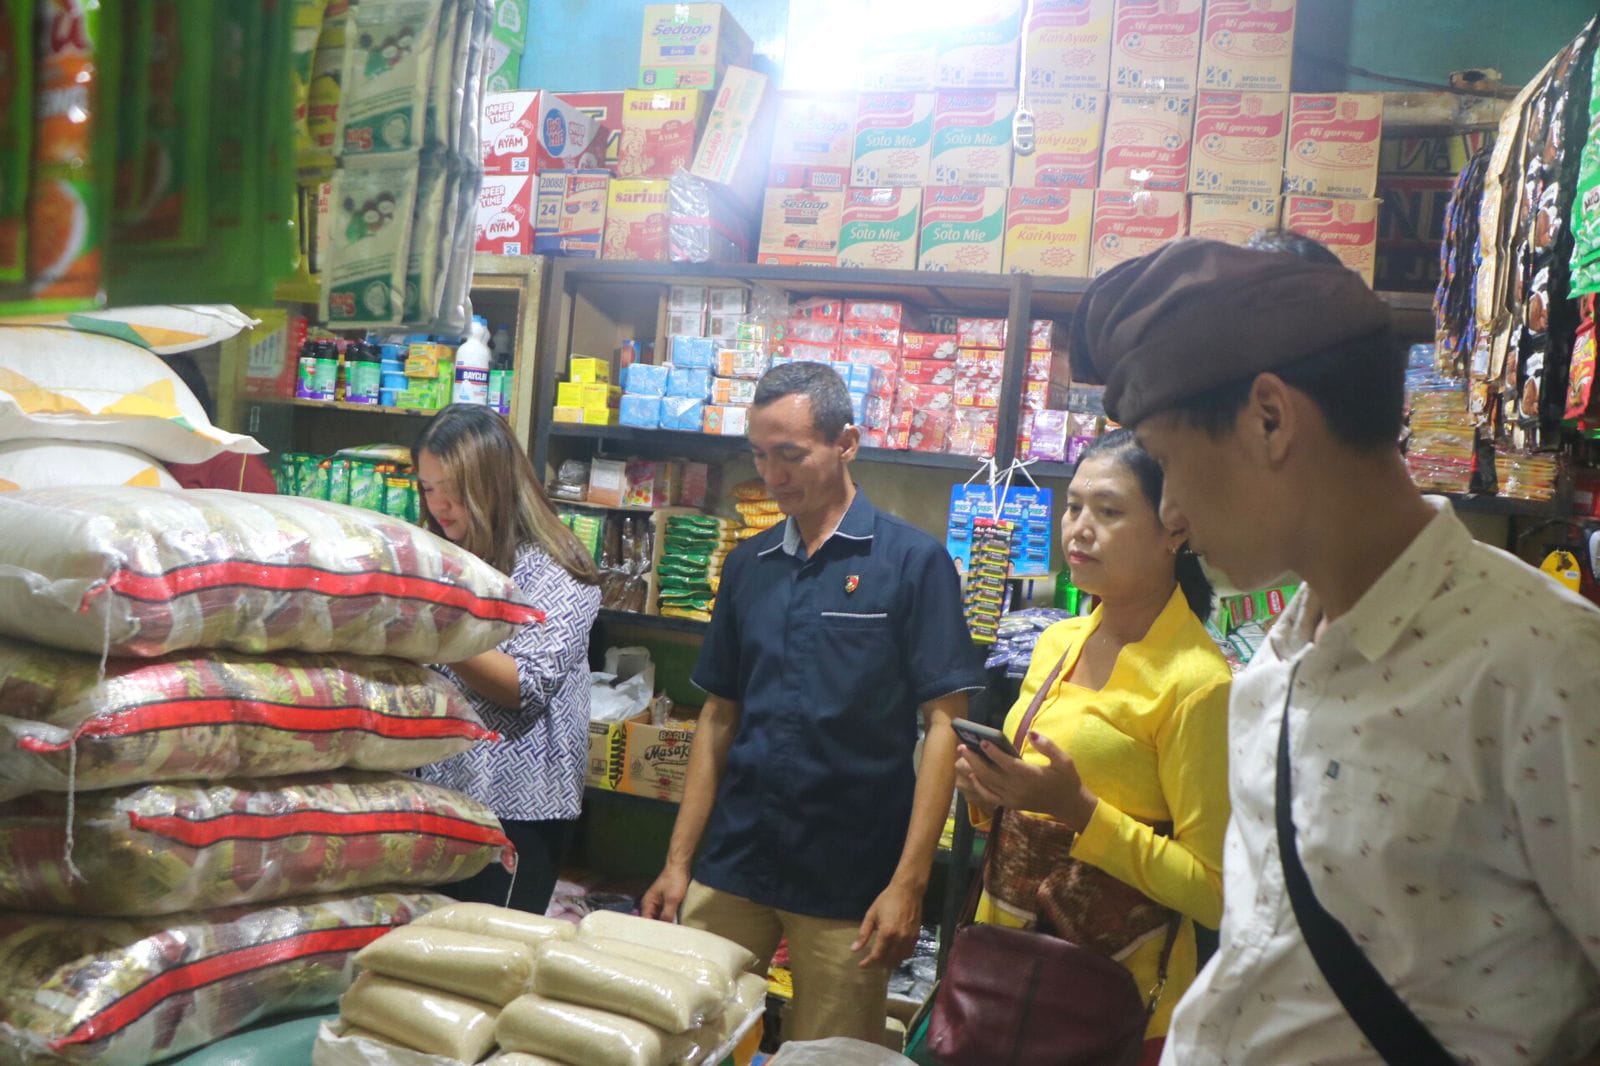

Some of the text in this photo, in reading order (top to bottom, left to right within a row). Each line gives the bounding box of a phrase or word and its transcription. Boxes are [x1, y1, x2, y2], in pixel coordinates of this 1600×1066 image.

[652, 24, 712, 36] Sedaap
[1229, 124, 1269, 135] goreng
[1323, 129, 1365, 140] goreng
[498, 138, 523, 149] AYAM
[865, 134, 917, 147] Soto Mie
[945, 132, 998, 145] Soto Mie
[514, 160, 526, 168] 24
[541, 203, 557, 216] 24
[591, 200, 599, 212] 2
[780, 199, 830, 211] Sedaap
[490, 221, 515, 233] AYAM
[1126, 225, 1164, 236] goreng
[849, 227, 901, 240] Soto Mie
[933, 227, 987, 241] Soto Mie
[1017, 231, 1078, 244] Kari Ayam
[1321, 231, 1360, 241] goreng
[507, 245, 518, 254] 24
[659, 730, 688, 741] BARU
[644, 745, 690, 761] Masak
